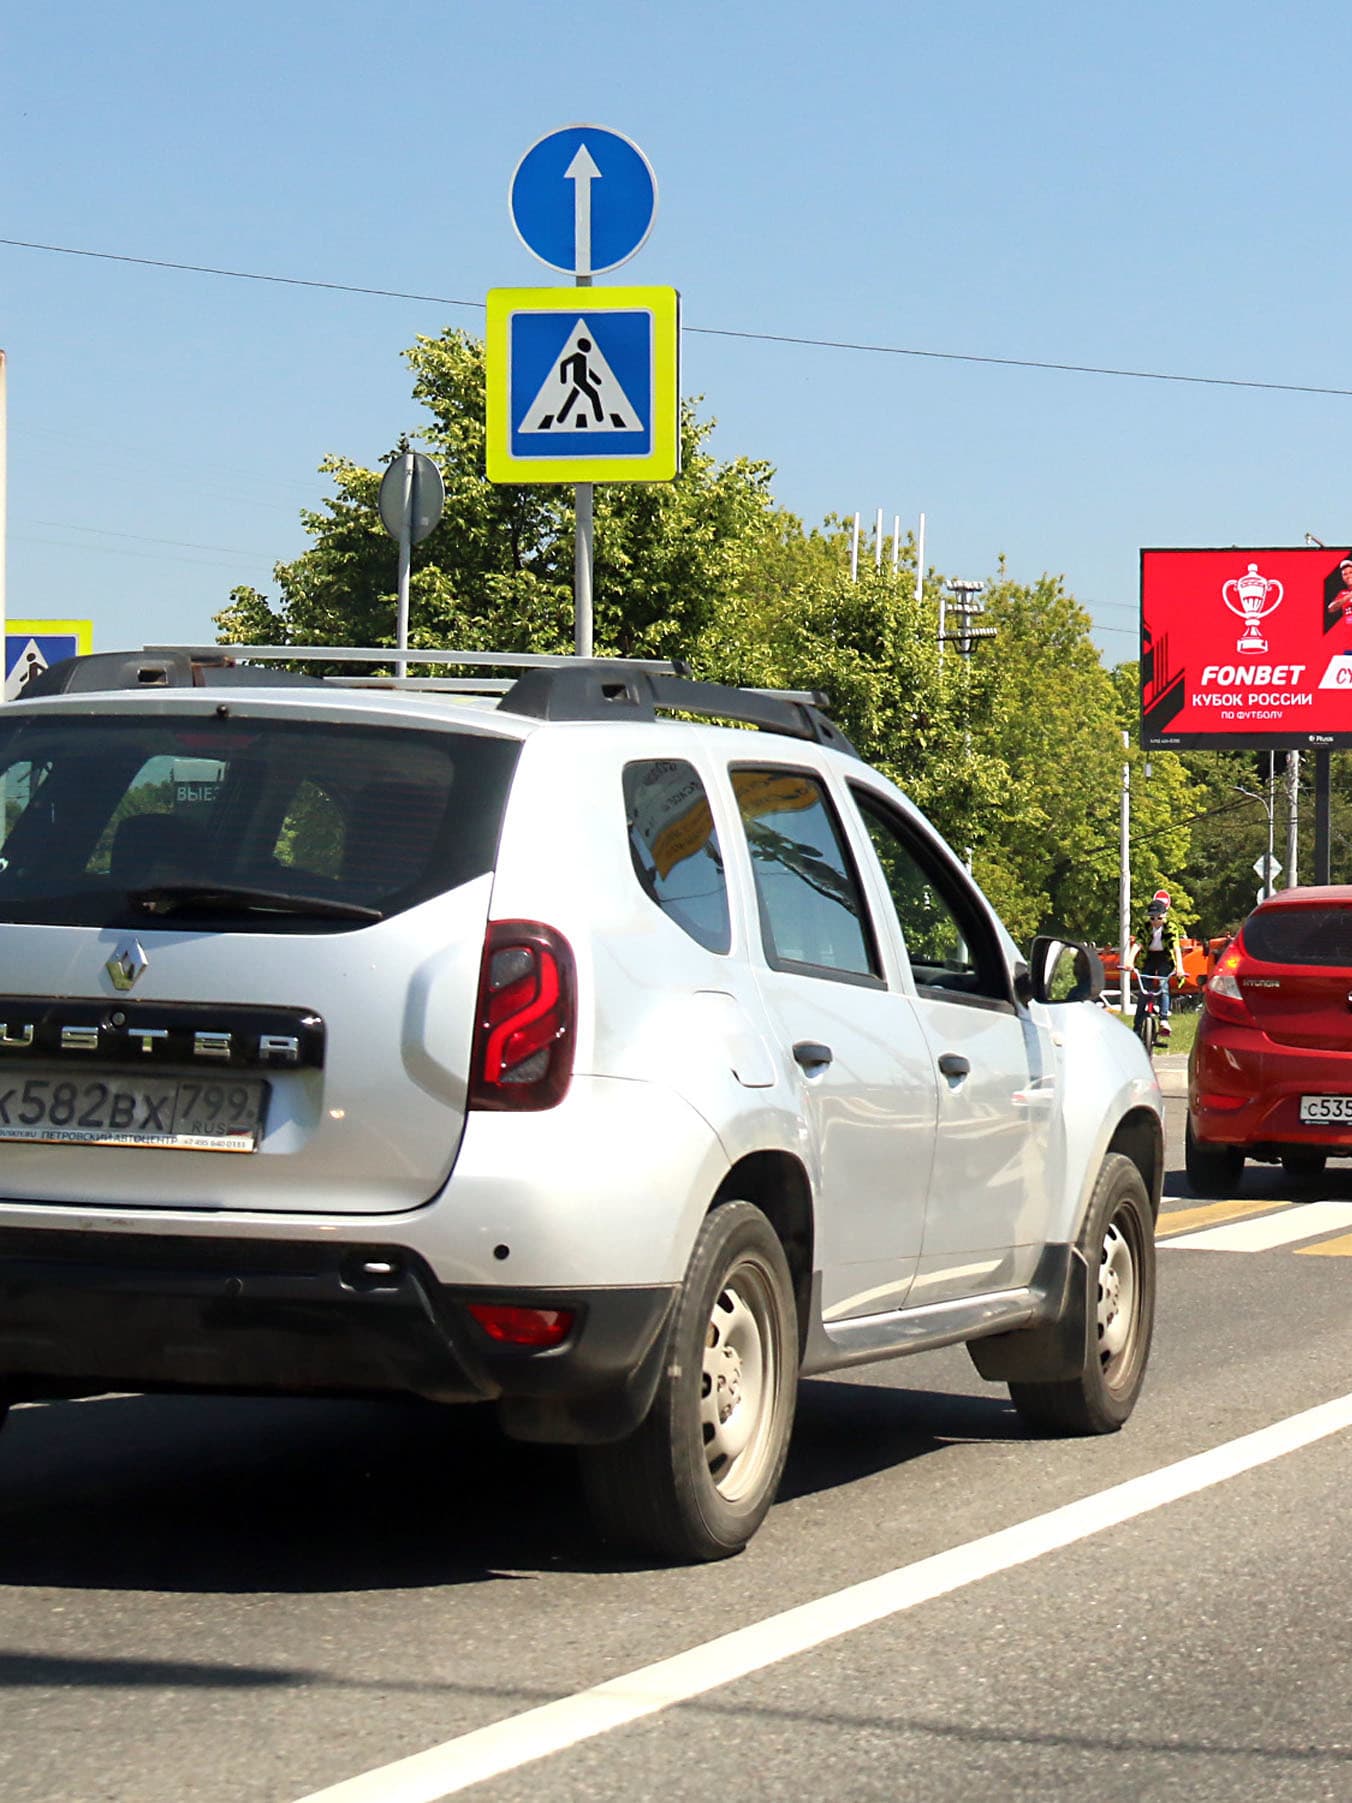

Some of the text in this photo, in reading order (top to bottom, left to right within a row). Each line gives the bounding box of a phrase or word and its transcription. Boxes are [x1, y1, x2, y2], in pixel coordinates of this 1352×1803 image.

[1201, 665, 1306, 686] FONBET
[1192, 693, 1312, 706] КУБОК РОССИИ
[1221, 711, 1283, 720] ПО ФУТБОЛУ
[182, 1084, 249, 1121] 799
[192, 1120, 226, 1134] RUS
